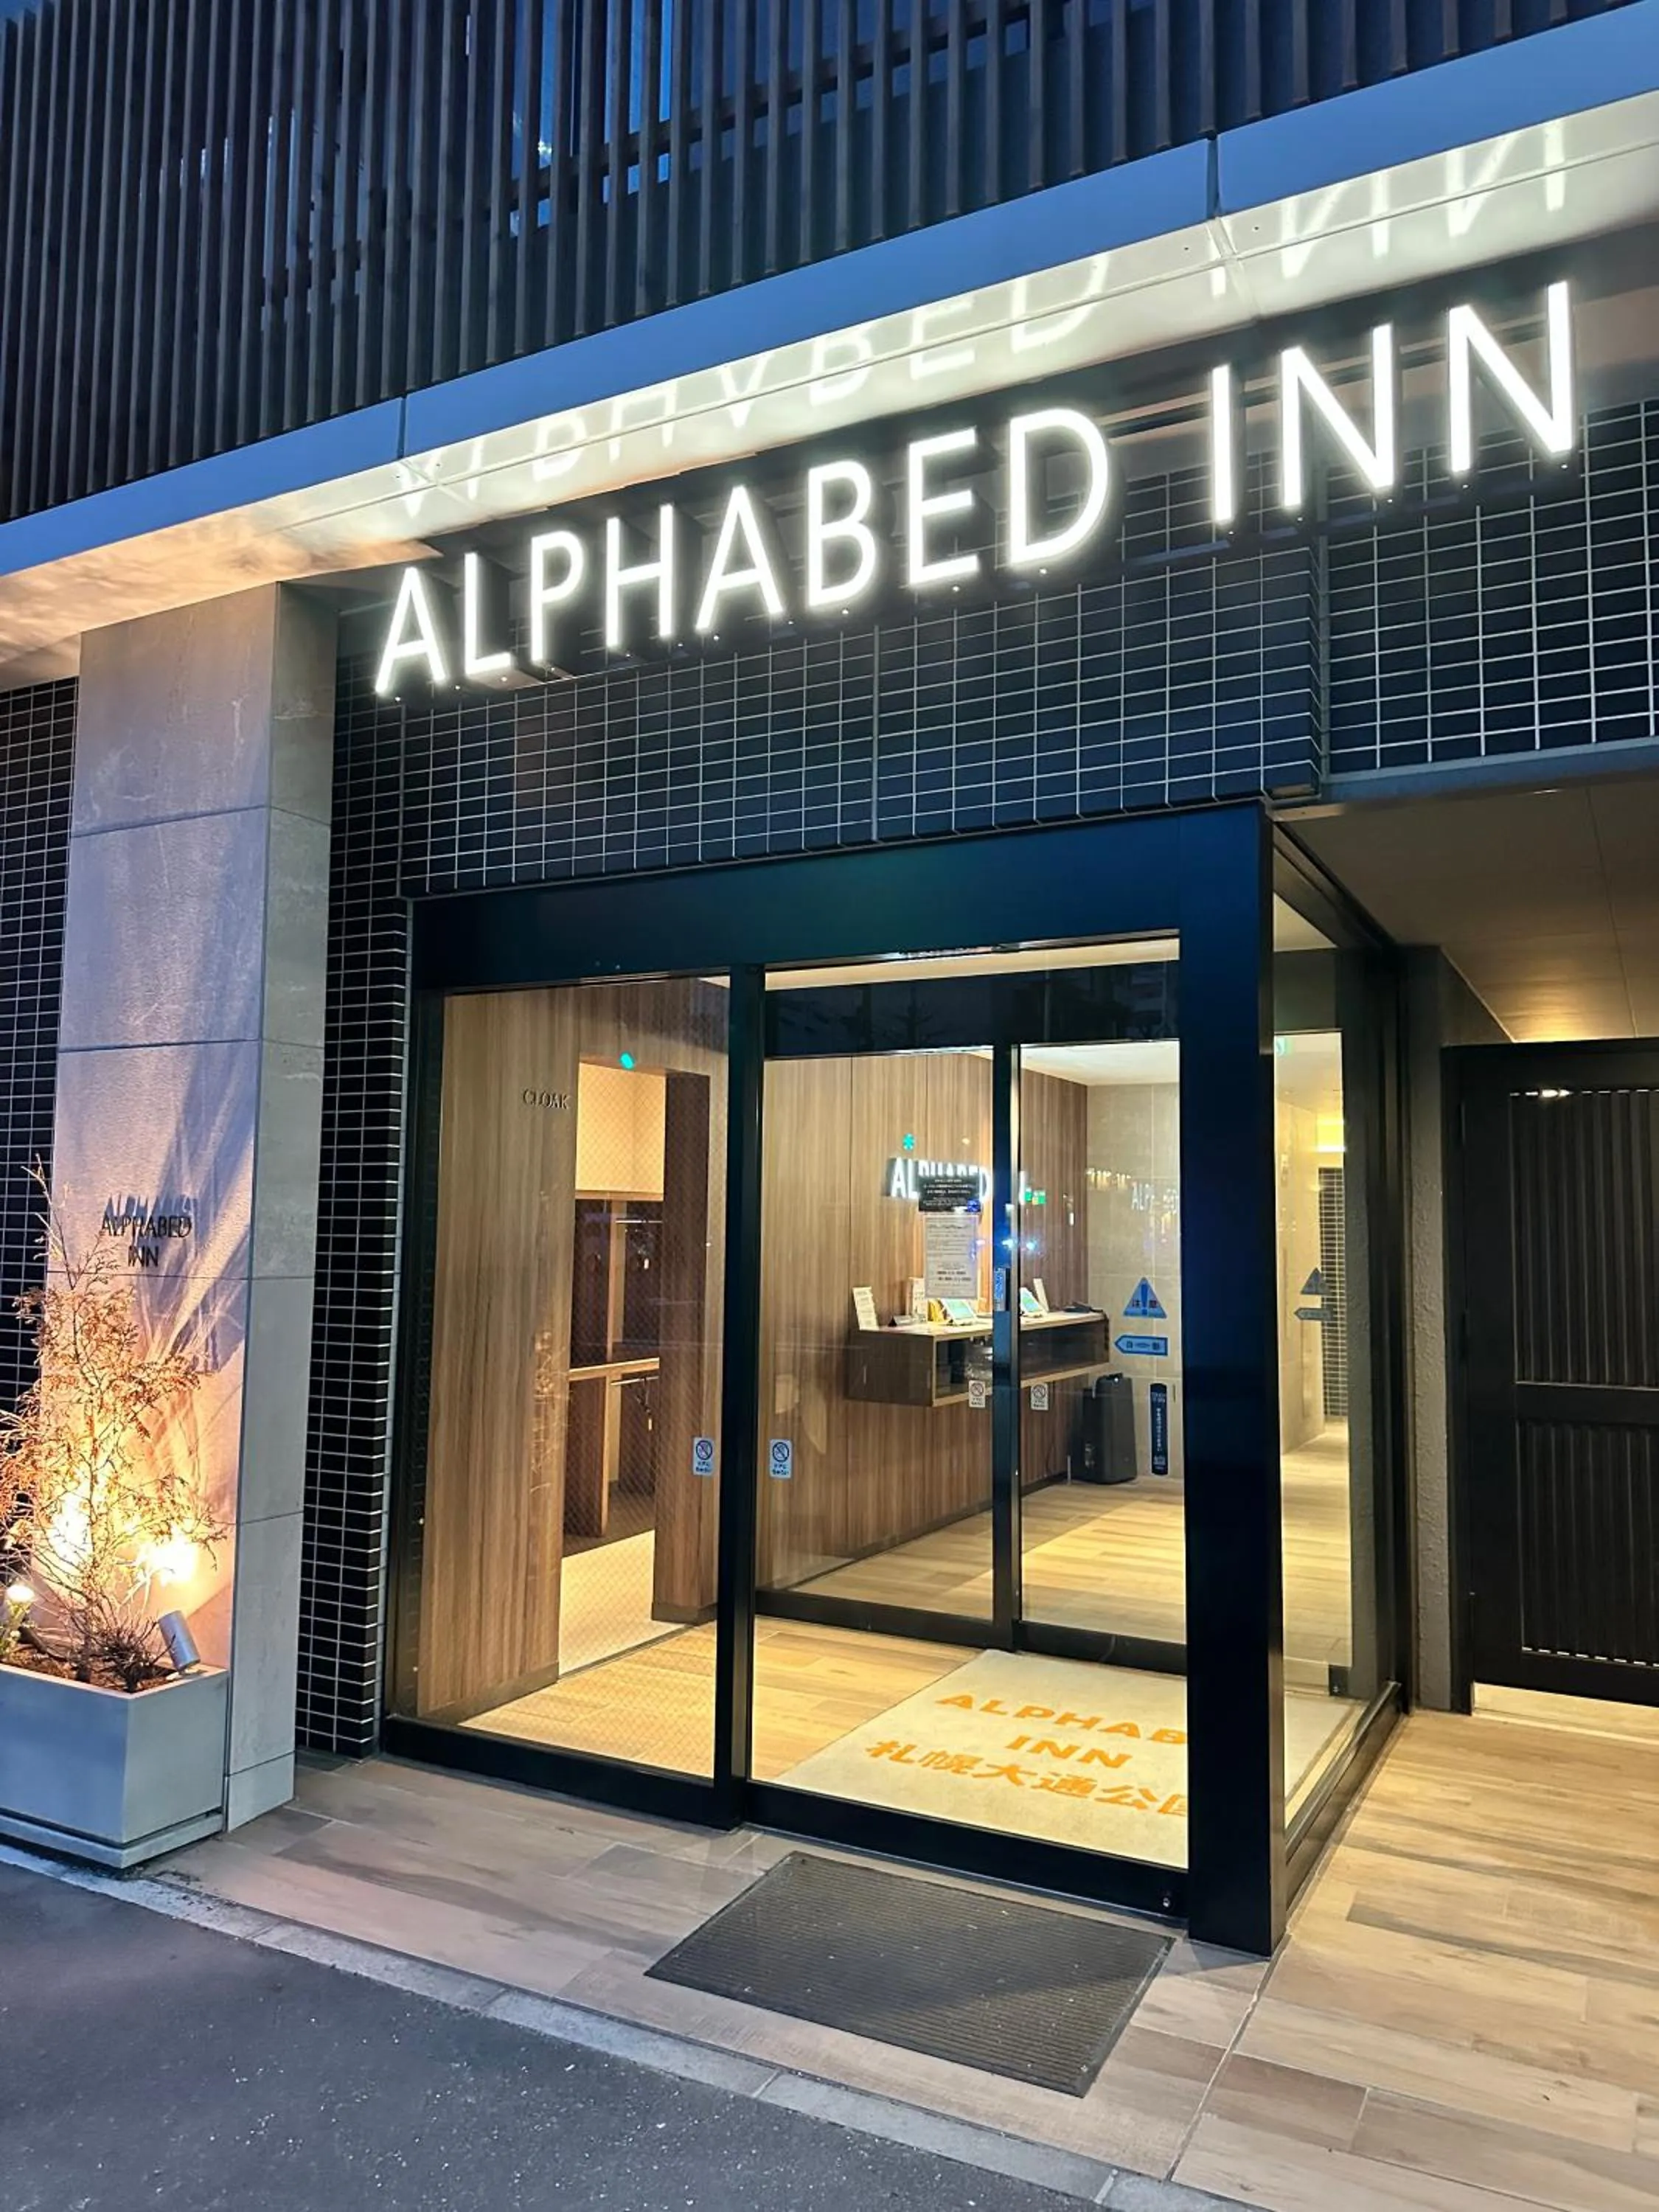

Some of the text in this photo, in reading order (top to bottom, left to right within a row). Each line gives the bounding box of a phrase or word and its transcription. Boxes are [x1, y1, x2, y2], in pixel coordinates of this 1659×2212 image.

[374, 280, 1573, 695] ALPHABED INN
[523, 1088, 568, 1109] CLOAK
[102, 1215, 192, 1238] ALPHABED
[128, 1245, 159, 1267] INN
[1006, 1734, 1133, 1769] INN
